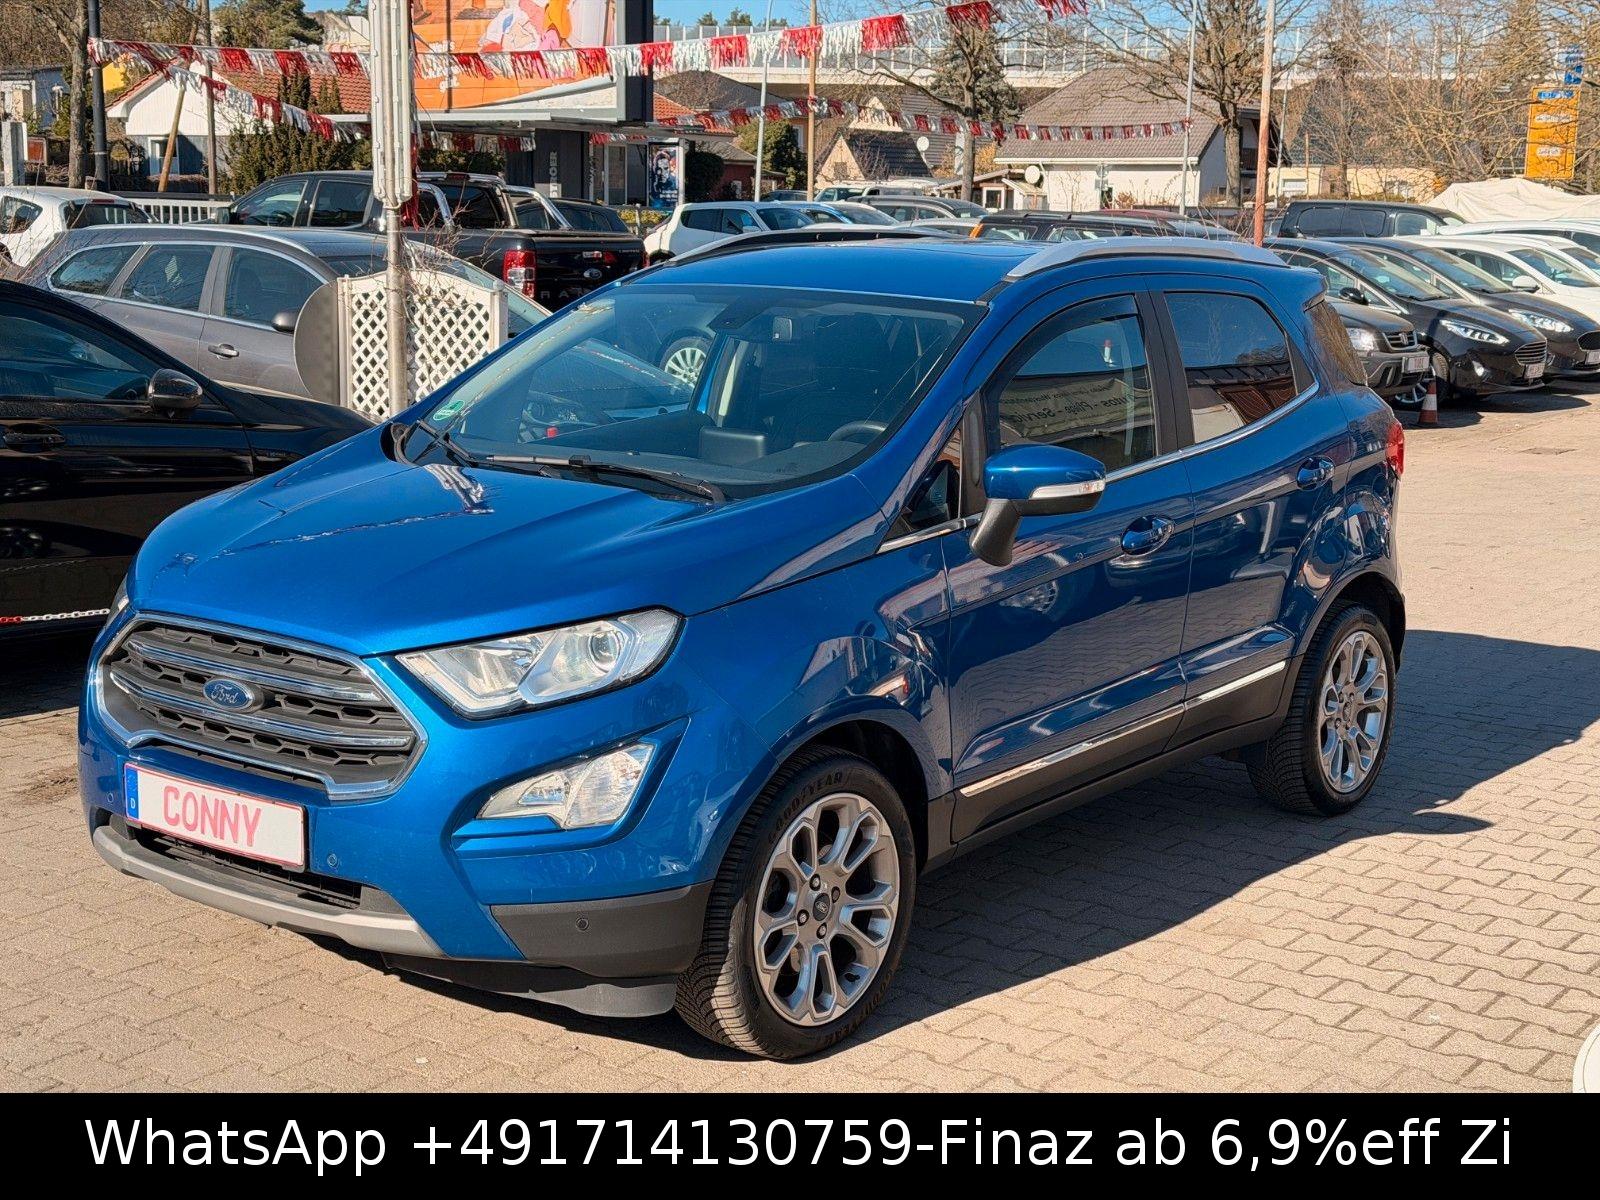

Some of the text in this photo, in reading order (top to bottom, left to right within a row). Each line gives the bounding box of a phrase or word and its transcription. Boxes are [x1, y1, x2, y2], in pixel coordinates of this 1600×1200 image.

[210, 683, 239, 704] Ford
[130, 797, 136, 809] D
[163, 785, 262, 847] CONNY
